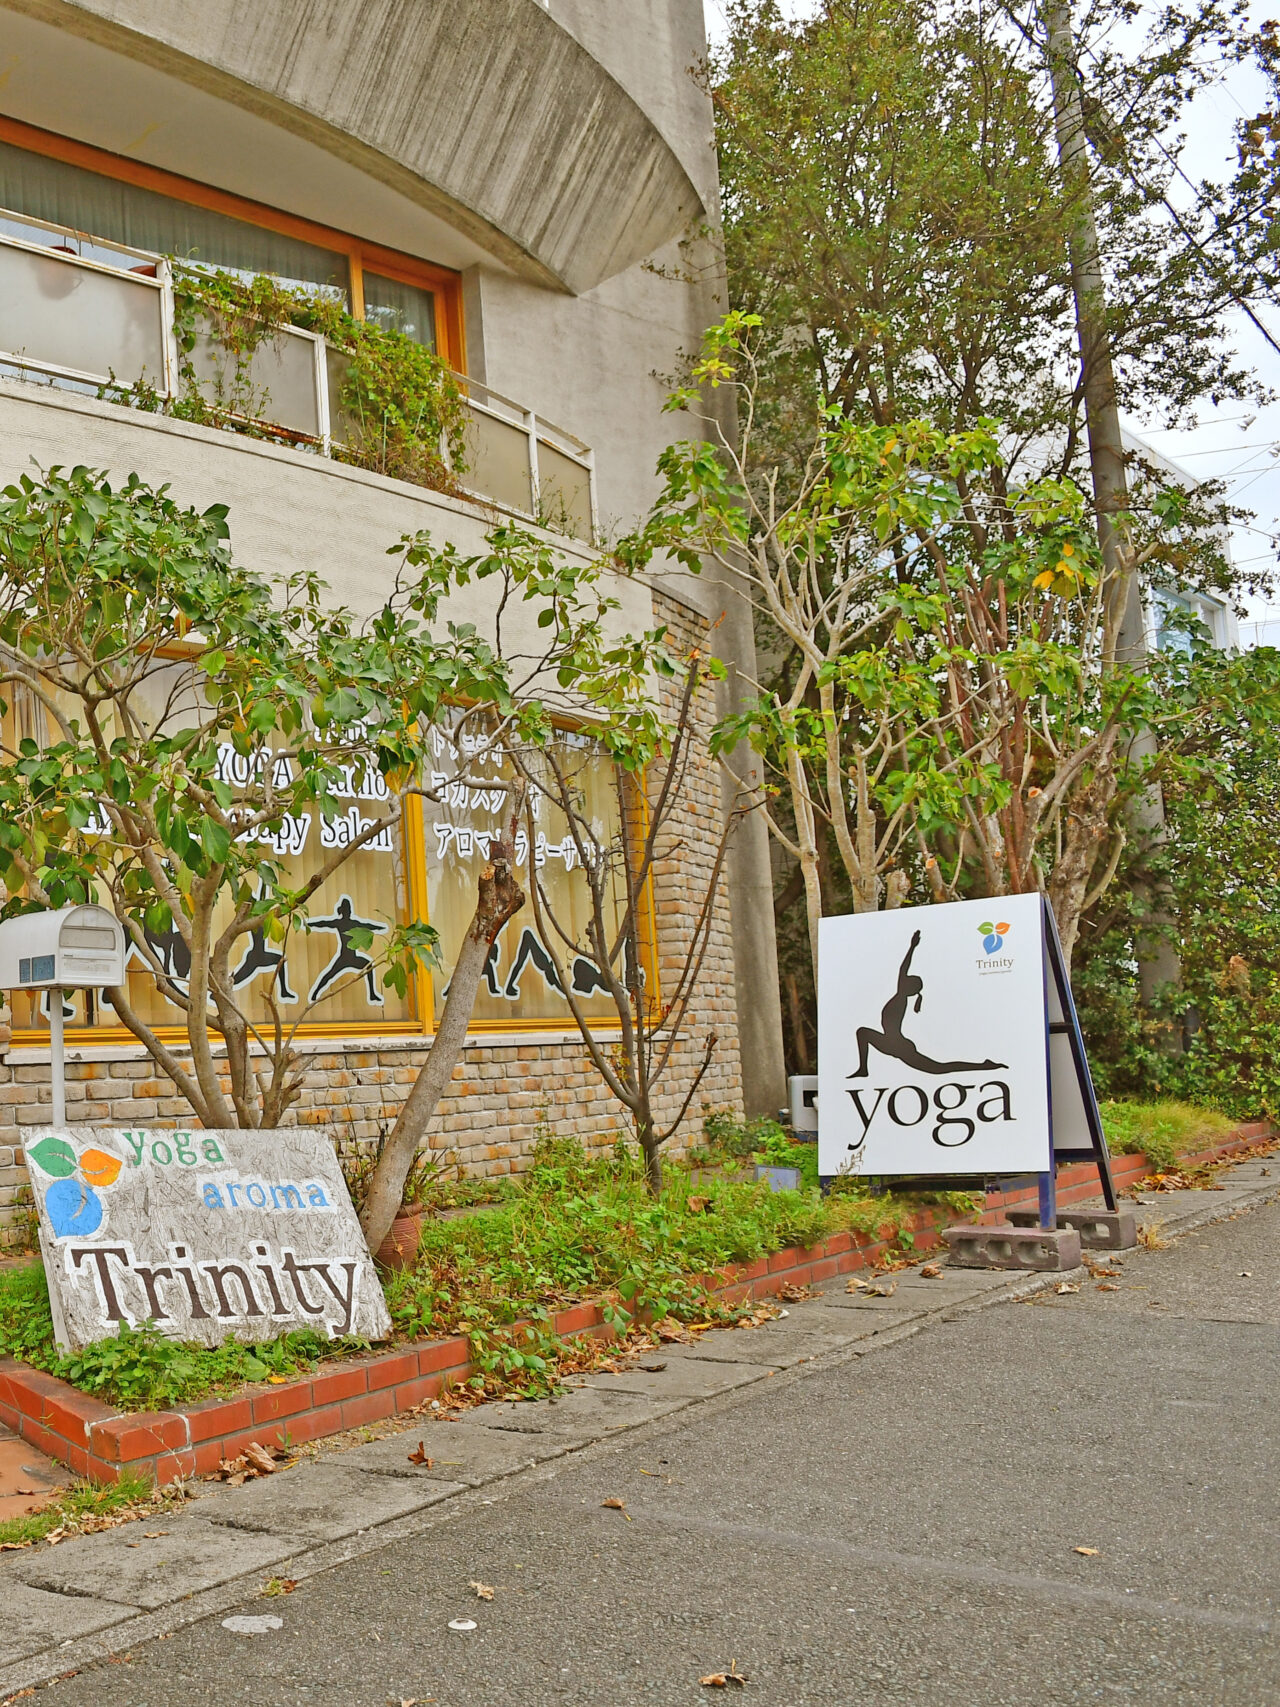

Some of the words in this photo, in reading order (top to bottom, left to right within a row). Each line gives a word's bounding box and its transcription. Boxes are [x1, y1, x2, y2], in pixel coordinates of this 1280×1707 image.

[976, 957, 1014, 969] Trinity
[845, 1080, 1017, 1151] yoga
[202, 1181, 330, 1209] aroma
[70, 1246, 357, 1336] Trinity
